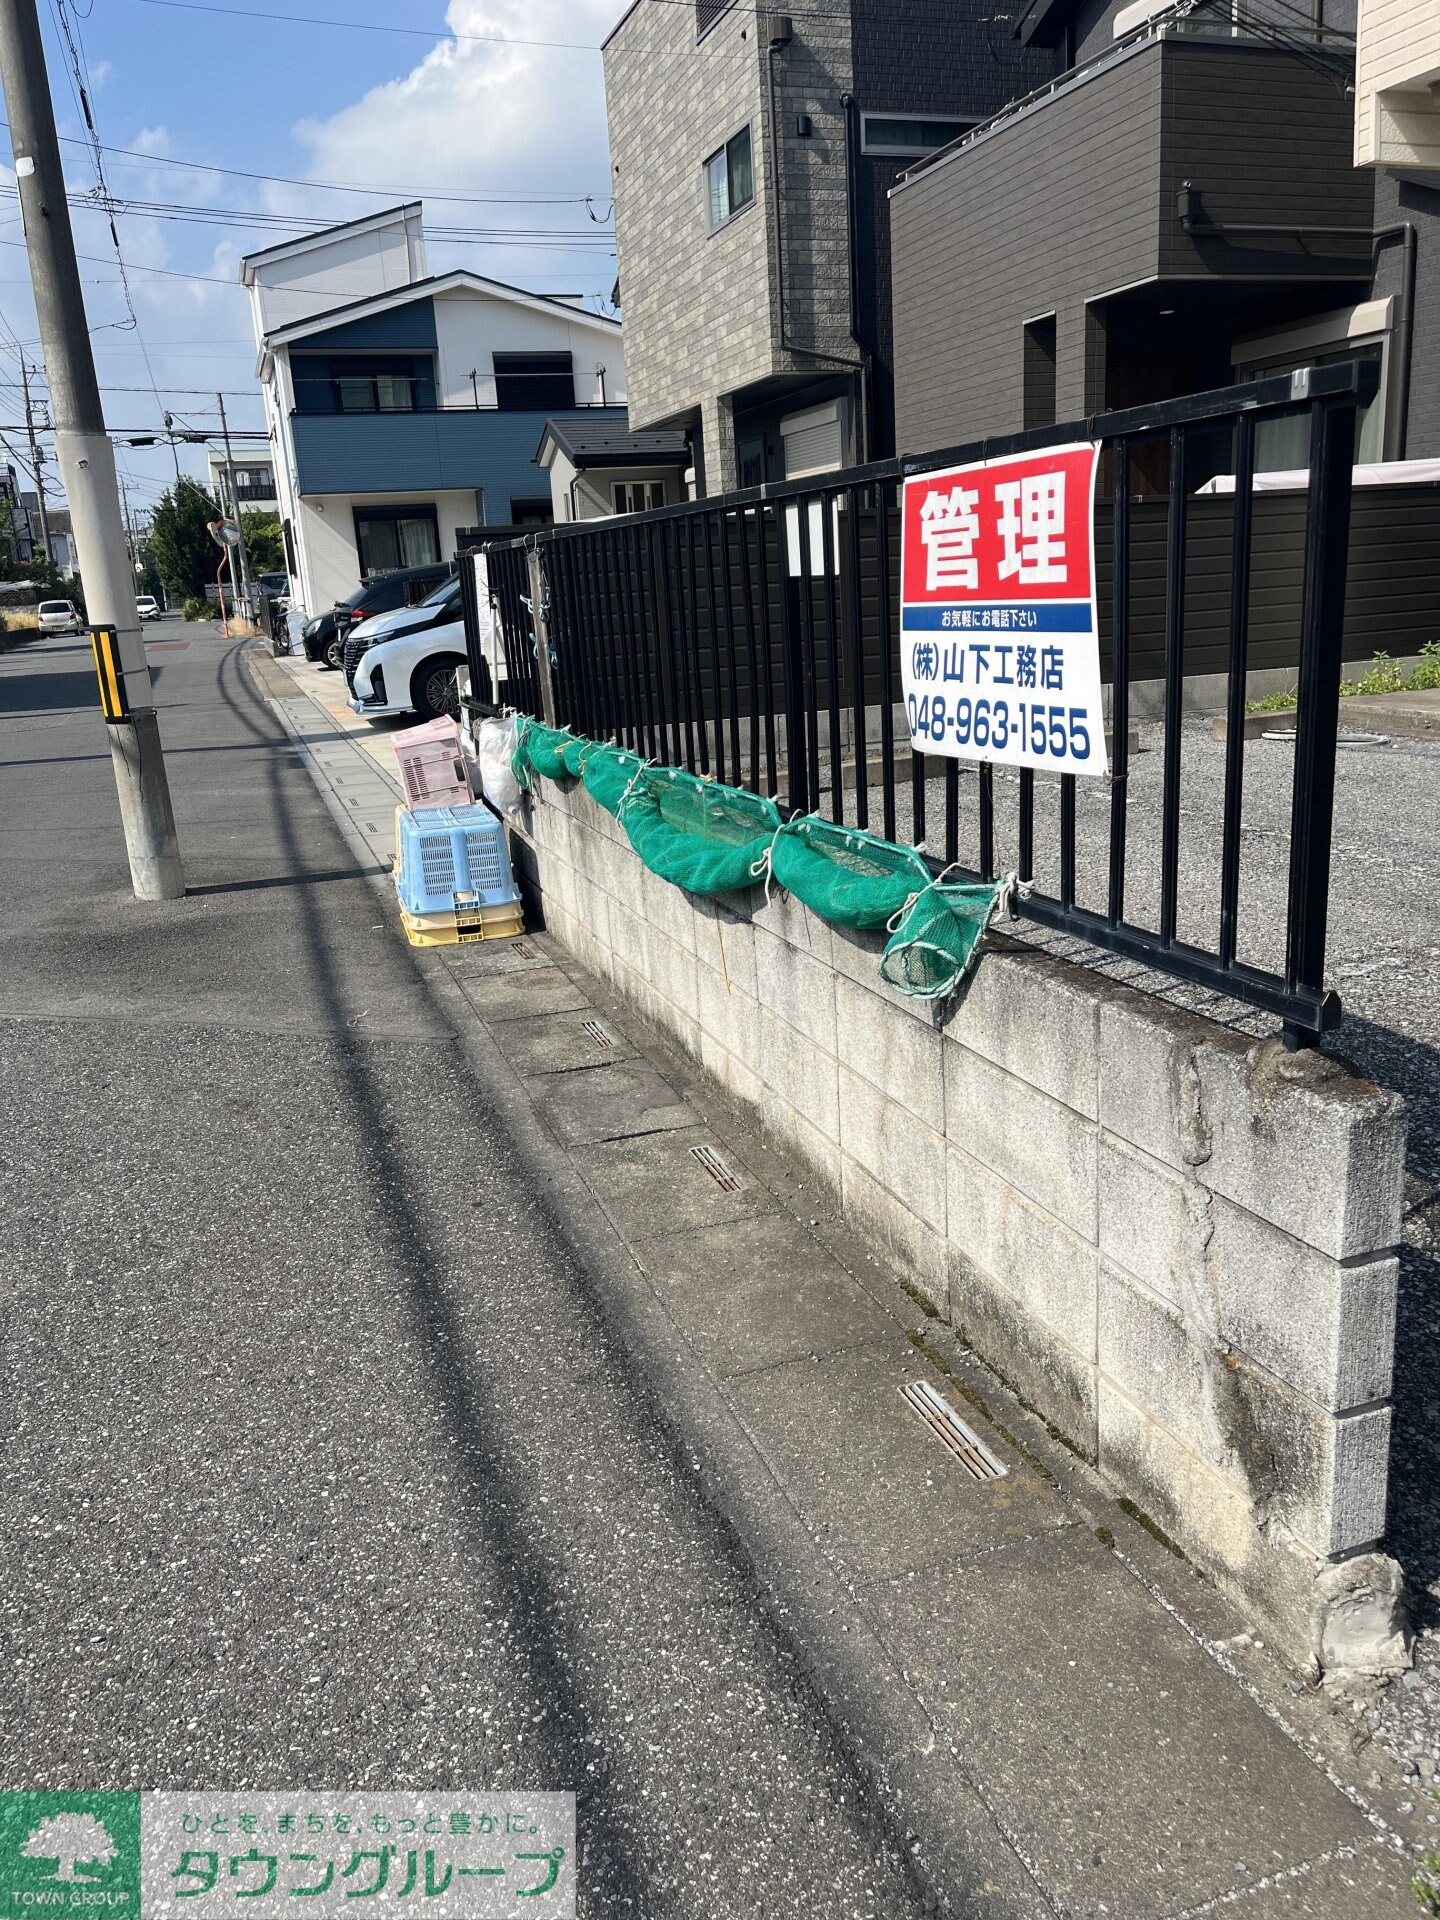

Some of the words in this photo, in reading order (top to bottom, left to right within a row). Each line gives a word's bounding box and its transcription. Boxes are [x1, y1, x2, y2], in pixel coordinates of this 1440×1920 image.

[919, 471, 1068, 592] 管理
[941, 609, 1037, 628] お気軽にお電話下さい
[912, 642, 1064, 691] (株)山下工務店
[908, 693, 1091, 760] 048-963-1555
